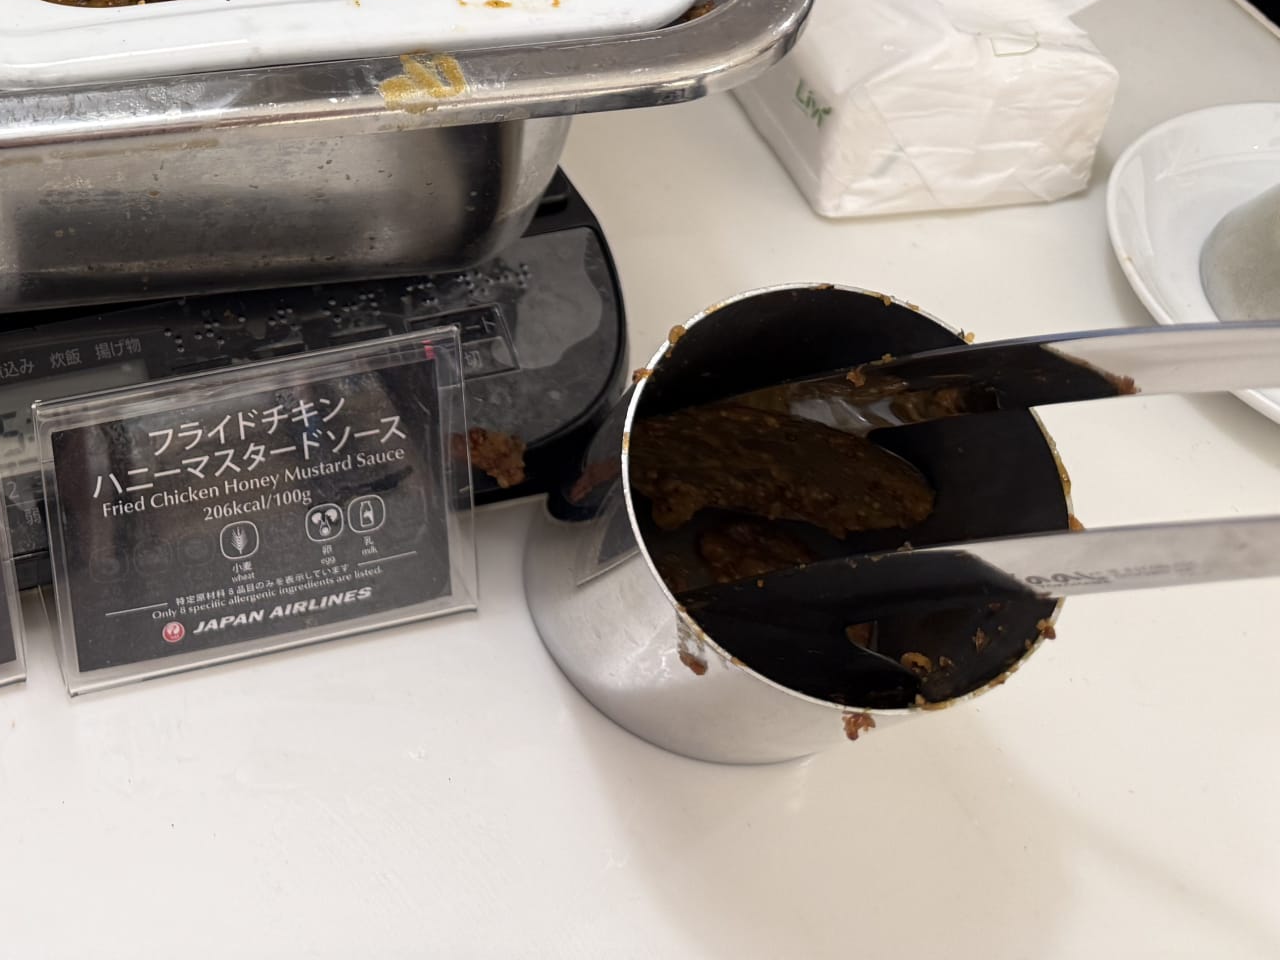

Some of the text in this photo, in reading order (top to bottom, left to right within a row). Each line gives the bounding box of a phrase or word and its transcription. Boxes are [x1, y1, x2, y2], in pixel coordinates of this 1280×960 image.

[50, 348, 82, 369] 炊飯
[95, 337, 142, 360] 揚げ物
[148, 397, 345, 456] フライドチキン
[92, 415, 407, 499] ハニーマスタードソース
[102, 447, 406, 518] Fried Chicken Honey Mustard Sauce
[202, 488, 313, 521] 206kcal/100g
[231, 571, 256, 583] wheat
[232, 560, 253, 573] 小麦
[320, 555, 337, 566] egg
[151, 565, 384, 620] Only 8 specific allergenic ingredients are listed.
[192, 586, 373, 634] JAPAN AIRLINES
